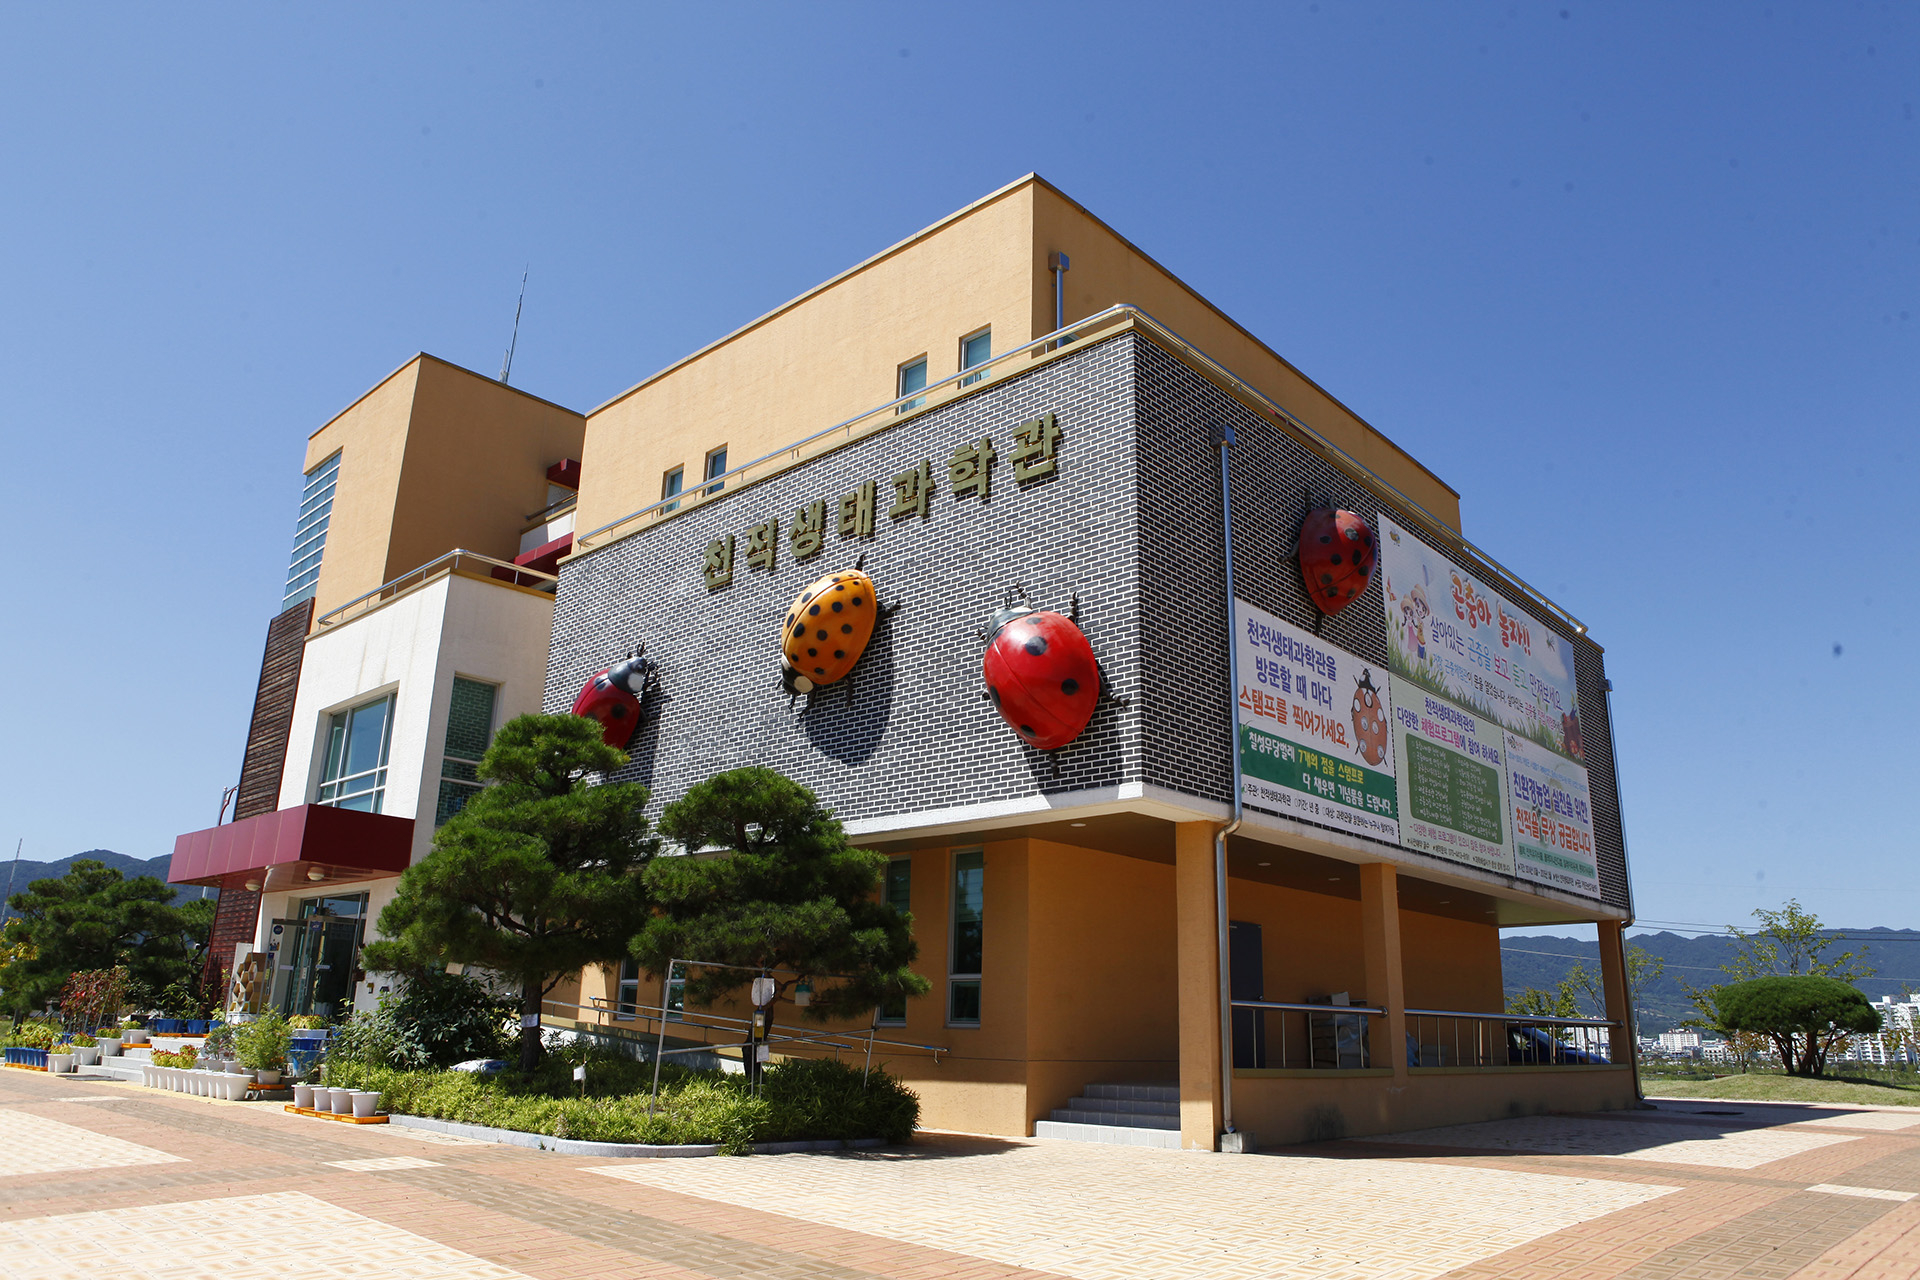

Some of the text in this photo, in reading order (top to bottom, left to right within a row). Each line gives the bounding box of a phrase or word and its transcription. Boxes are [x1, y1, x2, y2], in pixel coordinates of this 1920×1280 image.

[701, 411, 1063, 590] 천적생태과학관
[1451, 571, 1531, 657] 곤충아 놀자!!
[1246, 617, 1337, 681] 천적생태과학관을
[1430, 614, 1465, 657] 살아있는
[1466, 636, 1491, 671] 곤충을
[1255, 655, 1332, 710] 방문할 때 마다
[1238, 682, 1349, 747] 스탬프를 찍어가세요.
[1396, 706, 1419, 730] 다양한
[1420, 716, 1466, 750] 체험프로그램에
[1467, 738, 1480, 757] 참여
[1424, 697, 1475, 734] 천적생태과학관의
[1248, 731, 1363, 783] 칠성무당벌레 7개의 점을 스탬프로
[1260, 787, 1291, 806] 천적생태과학관
[1302, 773, 1392, 814] 다 채우면 기념품을 드립니다.
[1512, 770, 1551, 810] 친환경농업
[1551, 787, 1573, 818] 실천을
[1573, 797, 1588, 824] 위한
[1515, 806, 1539, 838] 천적을
[1540, 815, 1557, 845] 무상
[1557, 822, 1592, 856] 공급합니다
